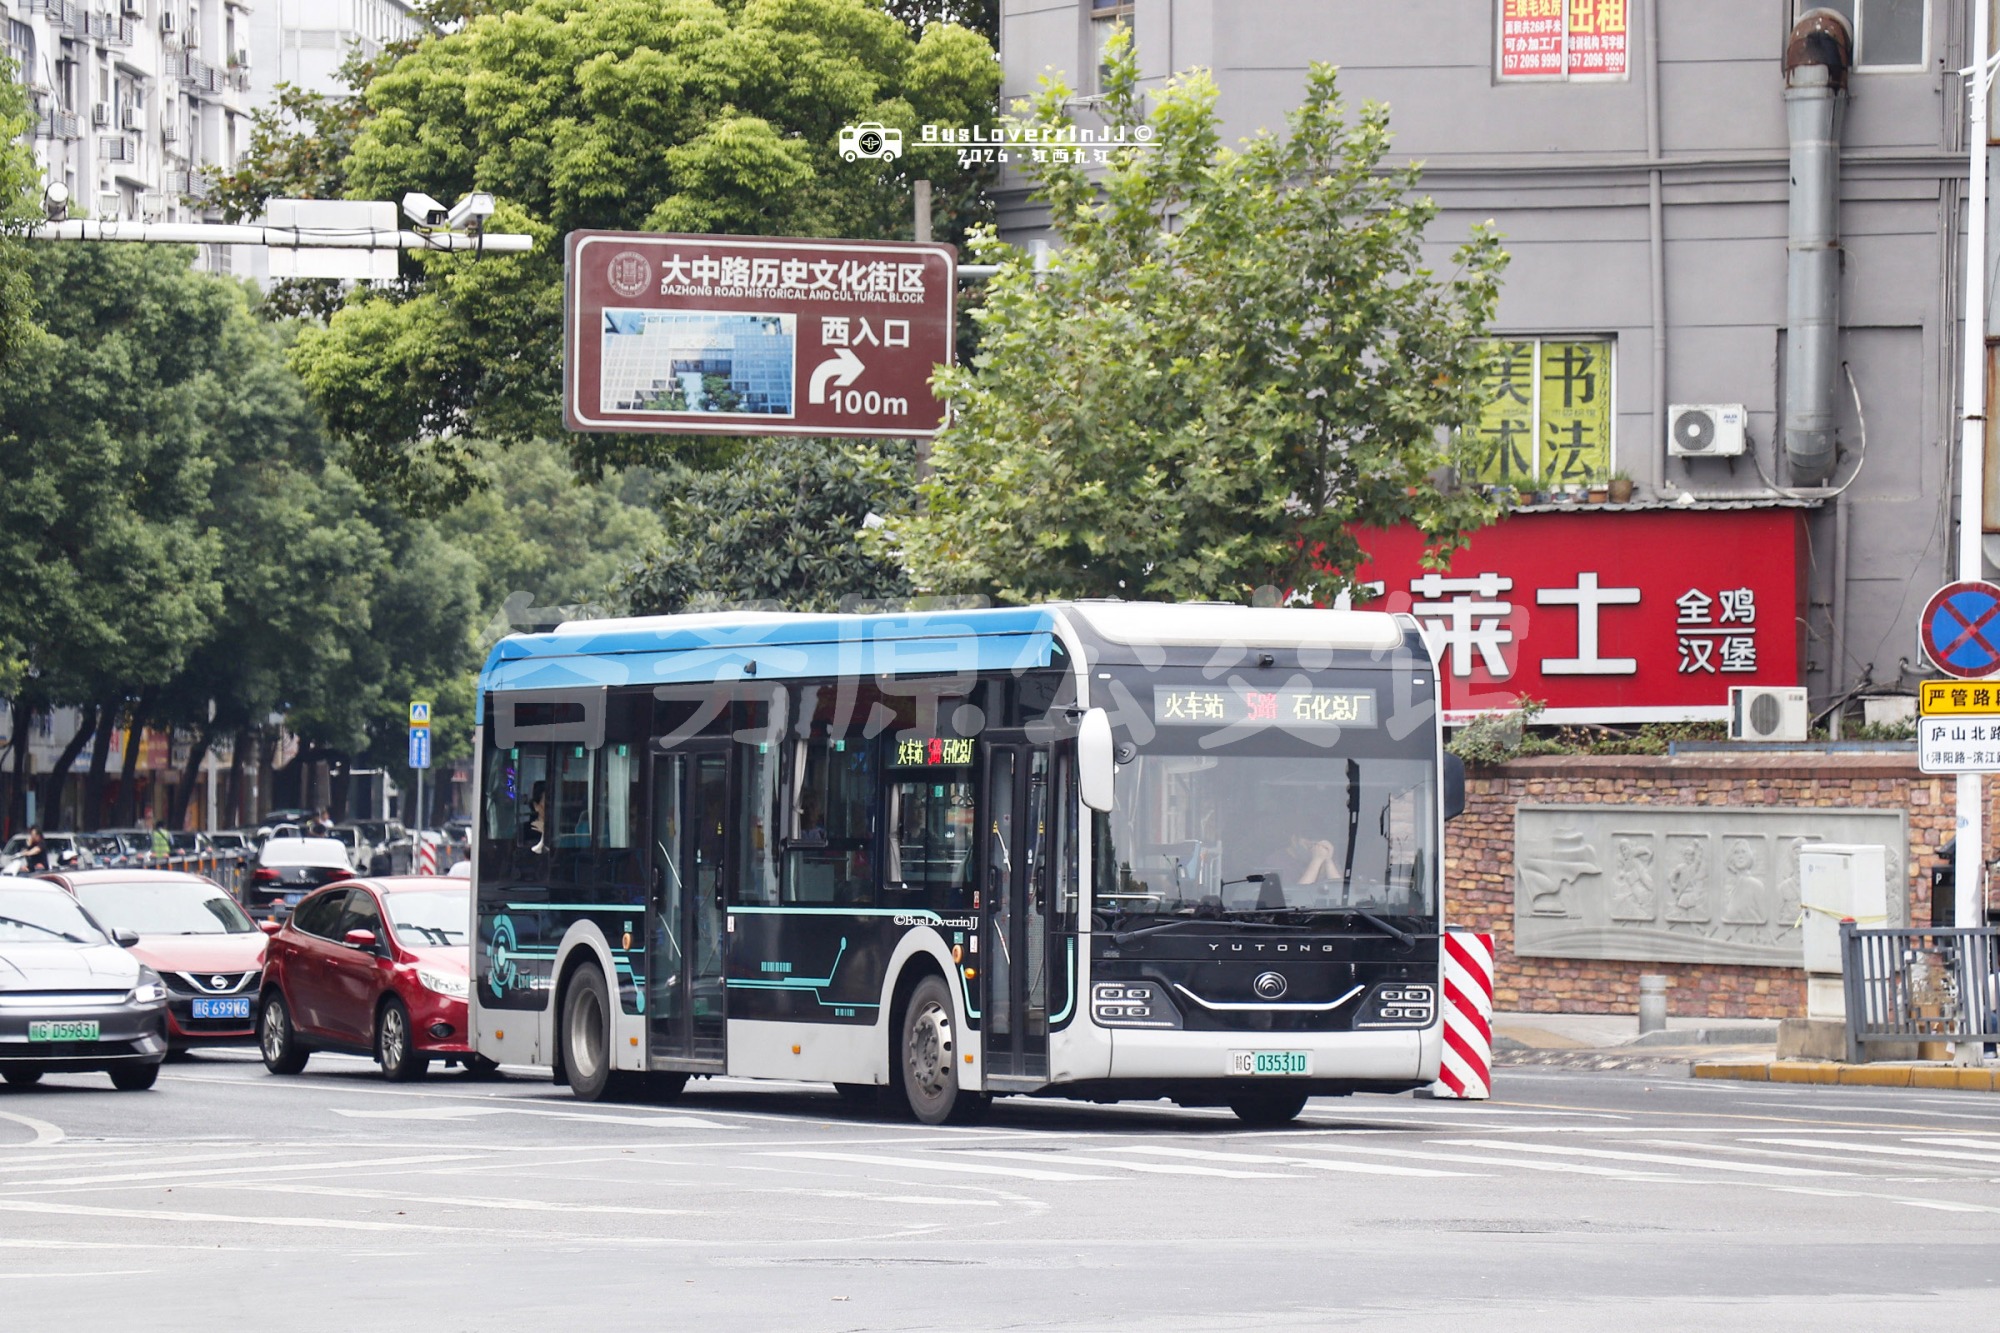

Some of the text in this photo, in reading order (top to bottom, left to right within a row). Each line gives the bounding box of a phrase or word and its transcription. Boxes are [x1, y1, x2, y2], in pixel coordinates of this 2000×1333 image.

[1569, 0, 1626, 33] 出租
[1504, 36, 1562, 52] 可办加工厂
[1504, 54, 1518, 69] 157
[661, 253, 926, 293] 大中路历史文化街区
[660, 284, 925, 304] DAZHONG ROAD HISTORICAL AND CULTURAL BLOCK
[821, 315, 911, 348] 西入口
[828, 390, 908, 416] 100m
[1543, 345, 1597, 481] 书法
[1676, 586, 1756, 625] 全鸡
[1289, 572, 1642, 676] 莱士
[1677, 635, 1758, 674] 汉堡
[1164, 691, 1224, 719] 火车站
[1292, 693, 1371, 720] 石化总厂
[1929, 688, 2000, 706] 严管路
[897, 738, 924, 766] 火车站
[942, 738, 976, 764] 石化总厂
[1208, 943, 1333, 952] YUTONG
